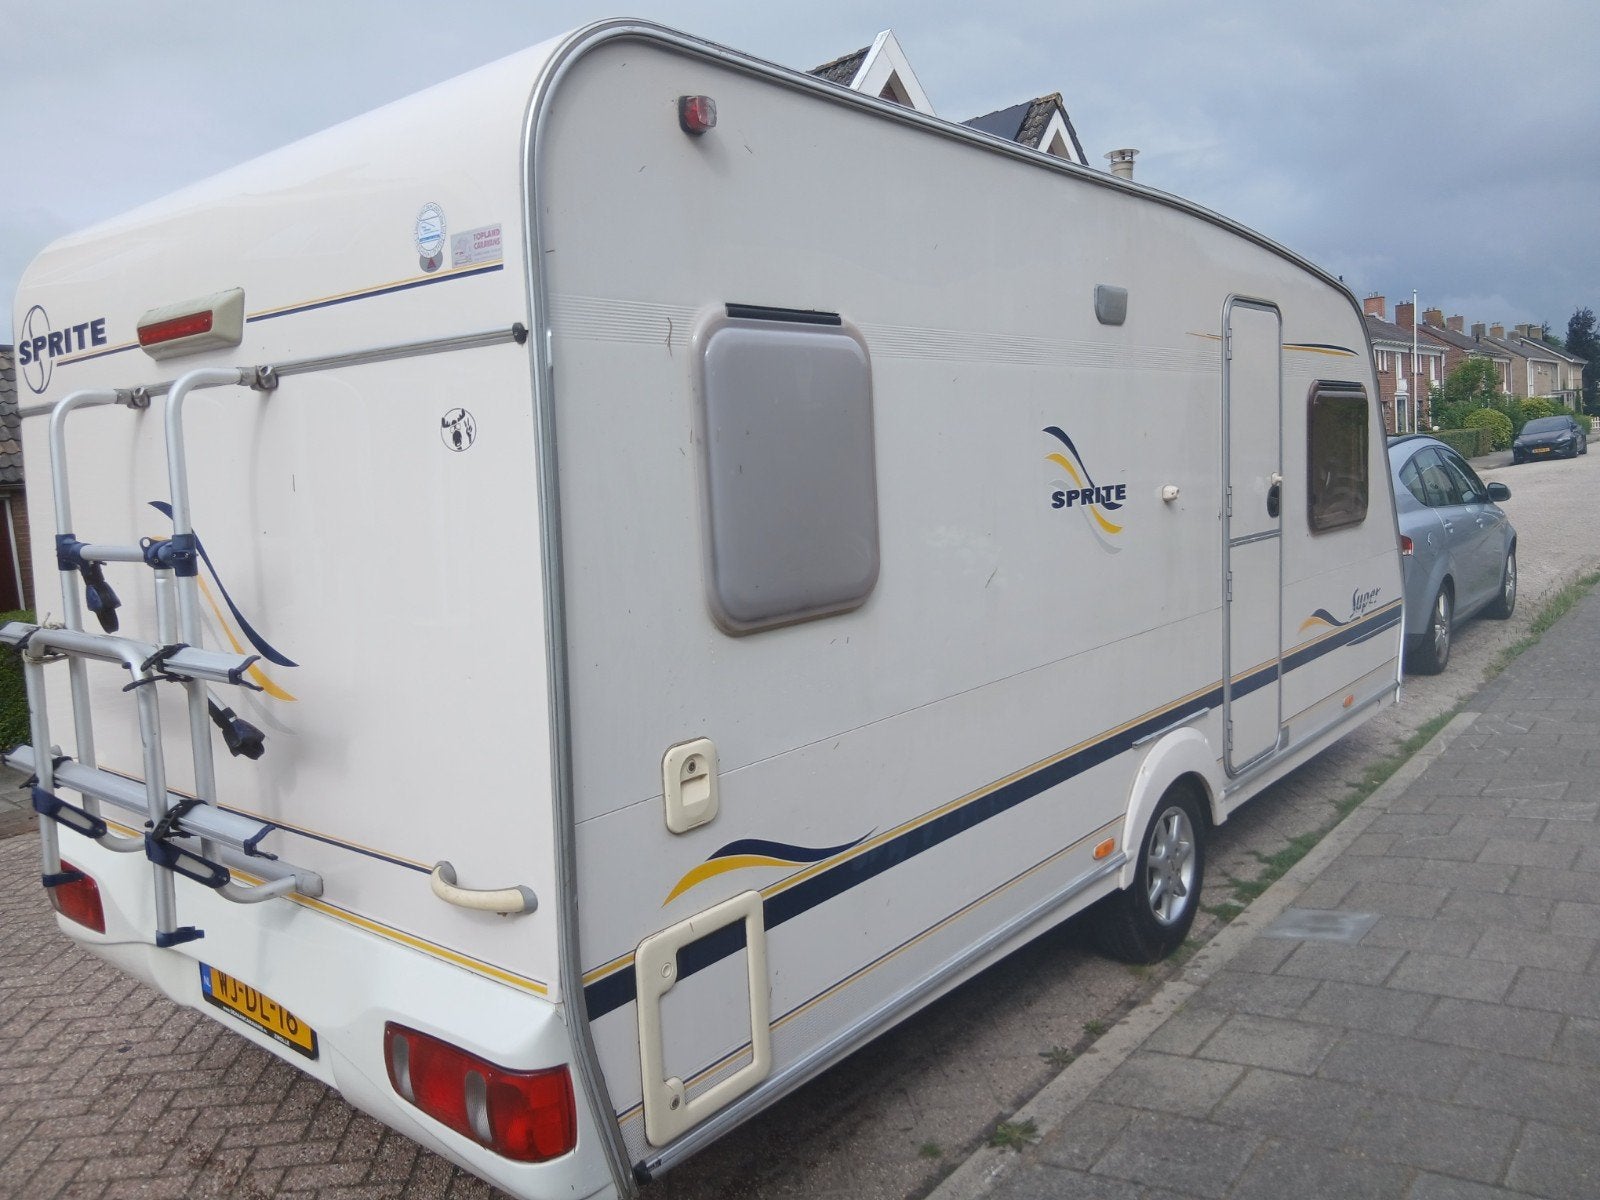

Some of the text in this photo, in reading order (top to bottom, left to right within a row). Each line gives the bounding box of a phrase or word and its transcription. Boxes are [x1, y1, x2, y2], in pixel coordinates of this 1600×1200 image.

[473, 228, 501, 241] TOPLAND
[19, 317, 107, 366] SPRITE
[1051, 483, 1127, 509] SPRITE
[1350, 587, 1382, 619] Super
